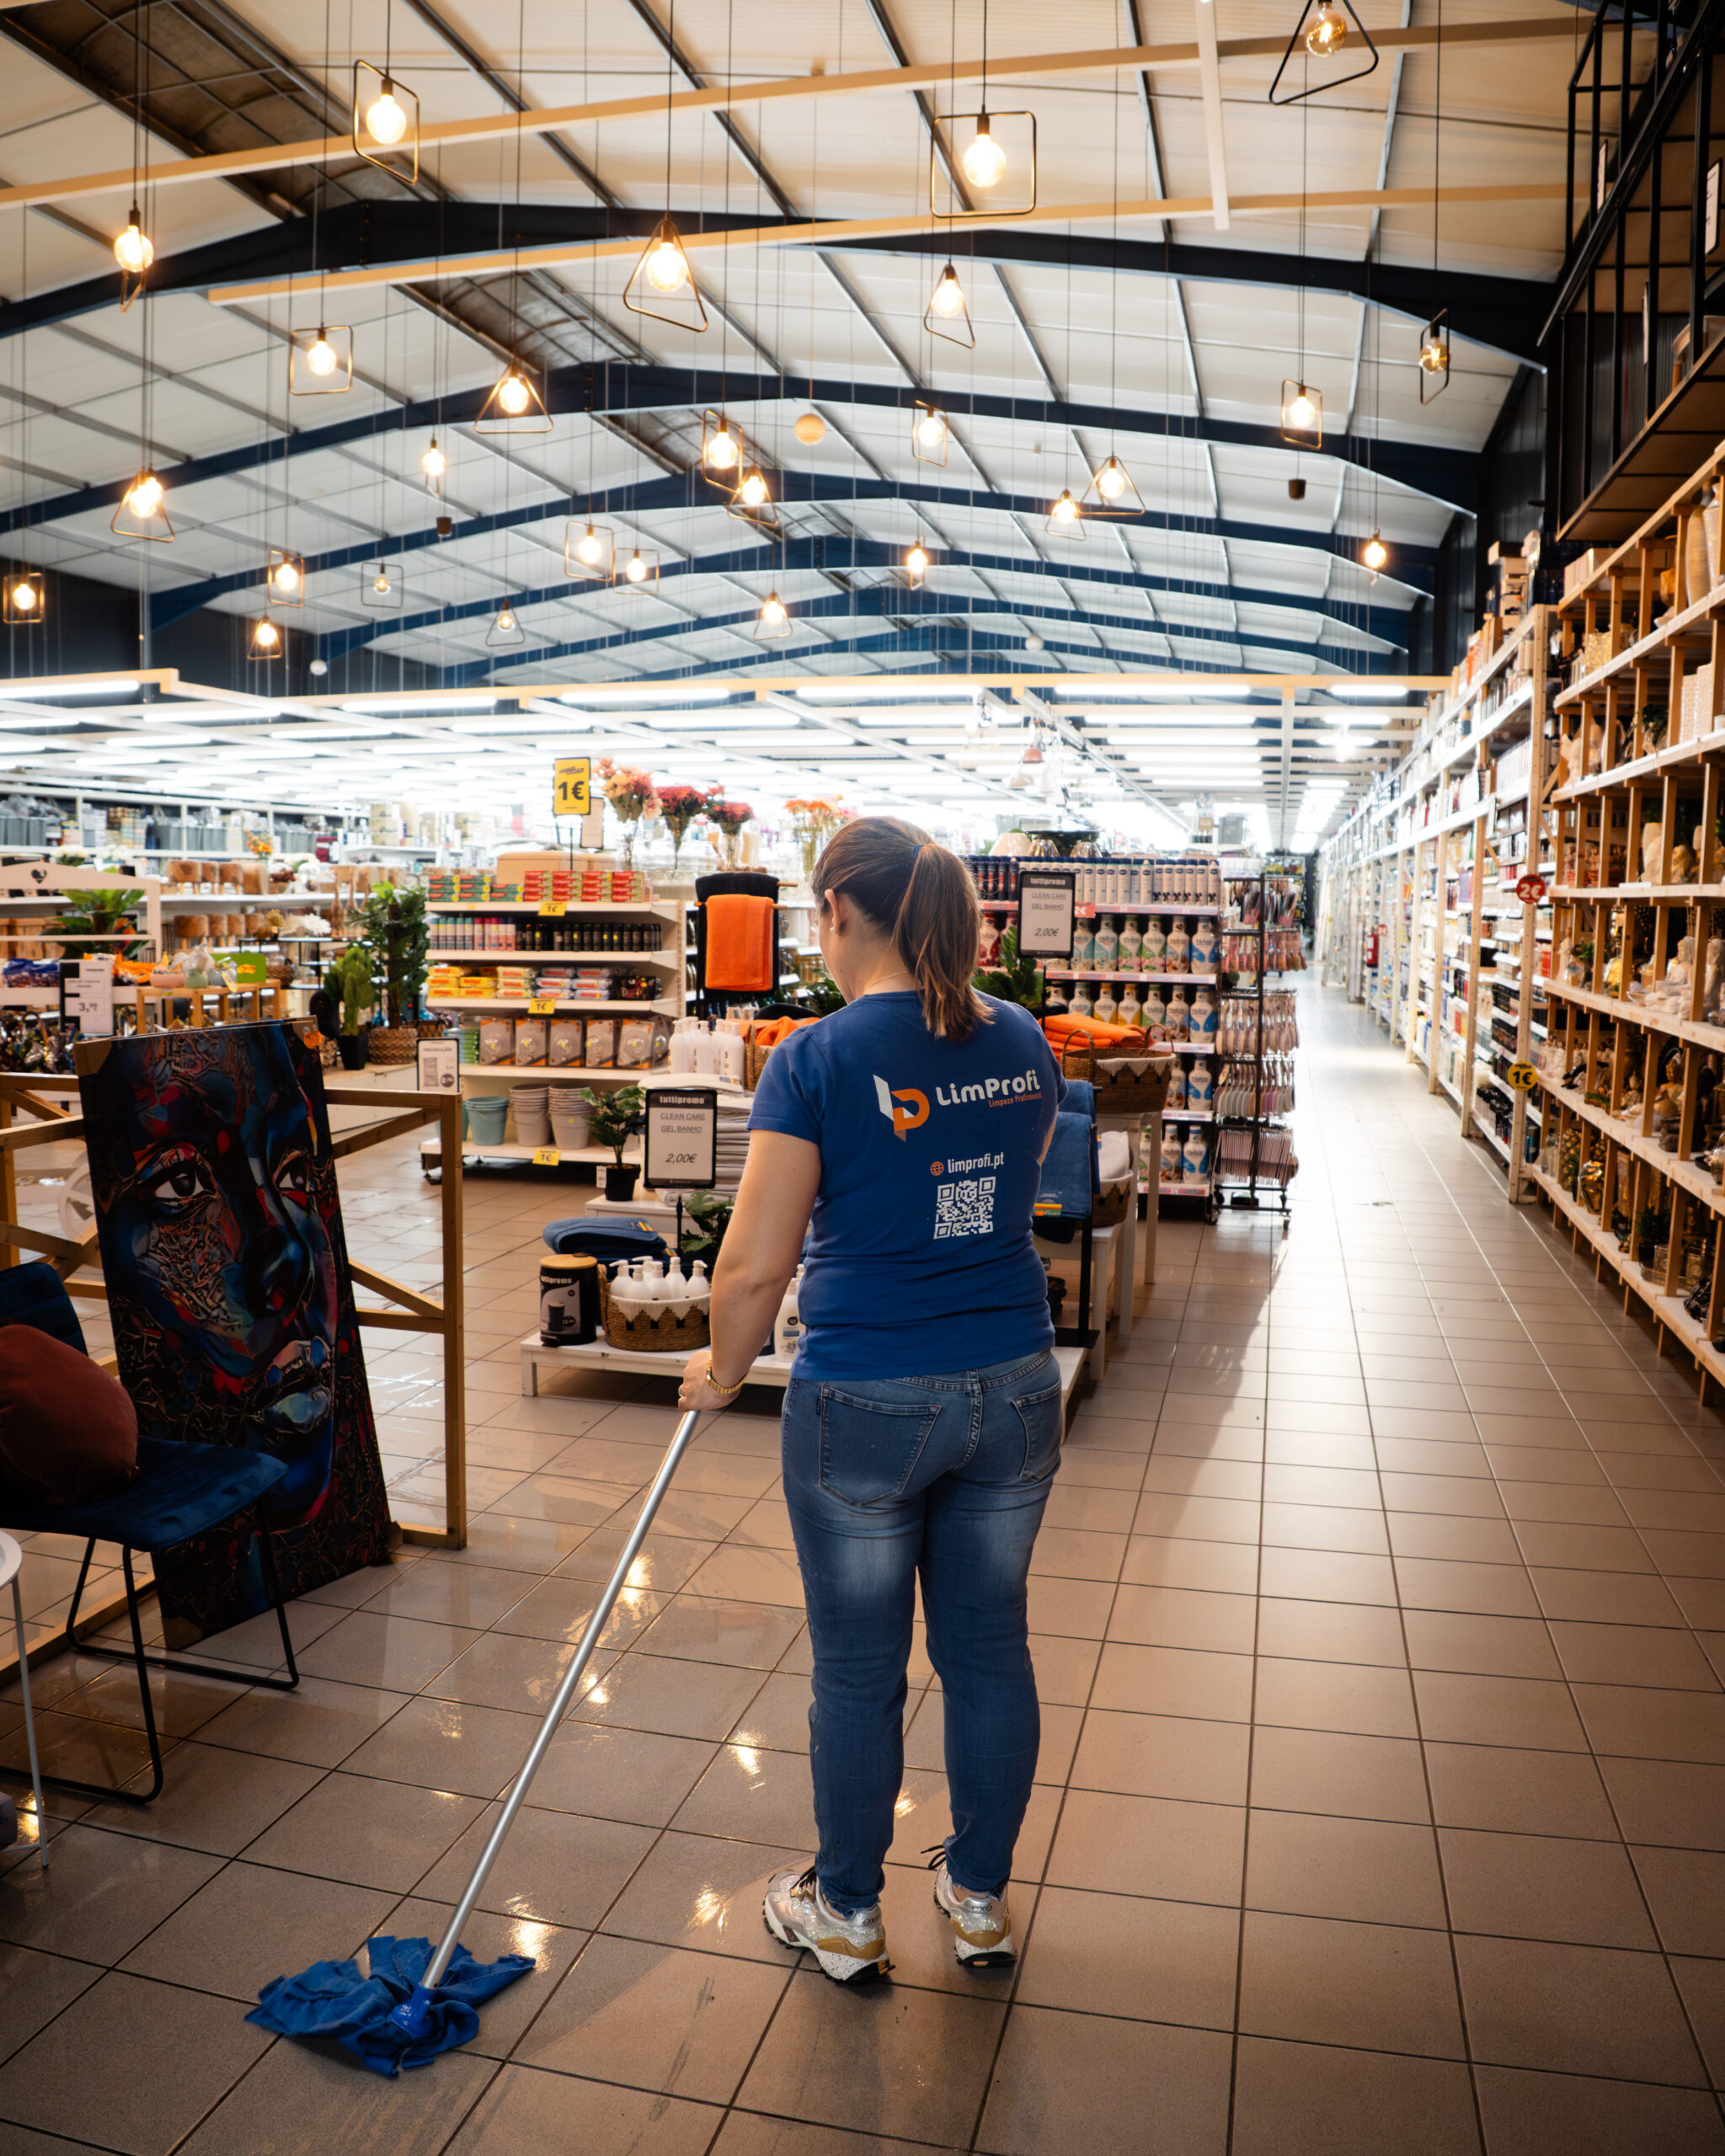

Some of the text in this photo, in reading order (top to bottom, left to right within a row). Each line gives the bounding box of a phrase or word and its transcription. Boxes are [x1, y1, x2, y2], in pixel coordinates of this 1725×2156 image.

[558, 781, 585, 801] 1€
[1519, 883, 1542, 899] 2€
[1034, 927, 1060, 937] 2,00€
[536, 1002, 547, 1011] 1€
[1513, 1070, 1533, 1085] 1€
[935, 1070, 1040, 1106] LimProfi
[660, 1096, 705, 1105] tuttipromo
[686, 1113, 706, 1121] CARE
[676, 1125, 702, 1134] BANHO
[541, 1154, 553, 1162] 1€
[665, 1153, 697, 1164] 2,00€
[948, 1152, 1004, 1173] limprofi.pt
